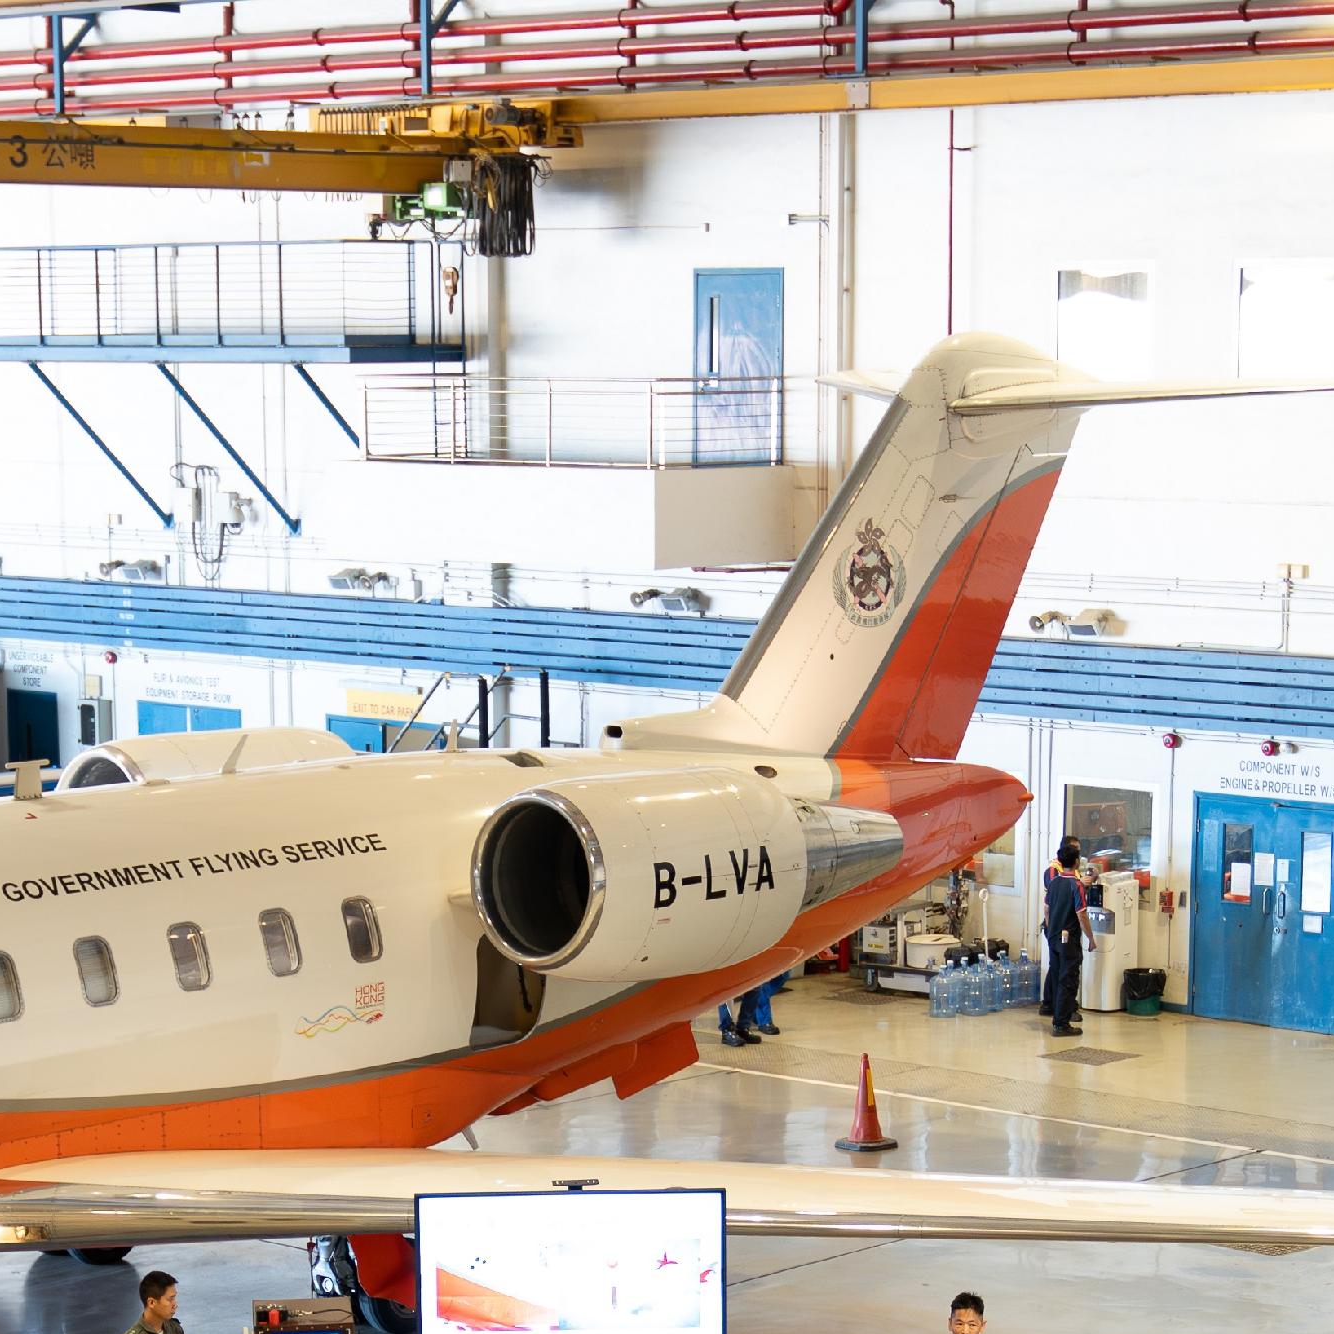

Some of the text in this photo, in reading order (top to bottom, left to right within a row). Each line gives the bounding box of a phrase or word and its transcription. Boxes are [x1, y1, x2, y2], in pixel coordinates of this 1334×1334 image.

[9, 135, 29, 169] 3
[12, 664, 48, 675] COMPONENT
[22, 677, 42, 688] STORE
[353, 703, 367, 713] EXIT
[370, 704, 379, 714] TO
[381, 705, 395, 716] CAR
[1239, 760, 1321, 778] COMPONENT W/S
[1220, 777, 1254, 791] ENGINE
[1262, 780, 1317, 797] PROPELLER
[1, 833, 388, 903] GOVERNMENT FLYING SERVICE
[652, 845, 775, 909] B-LVA
